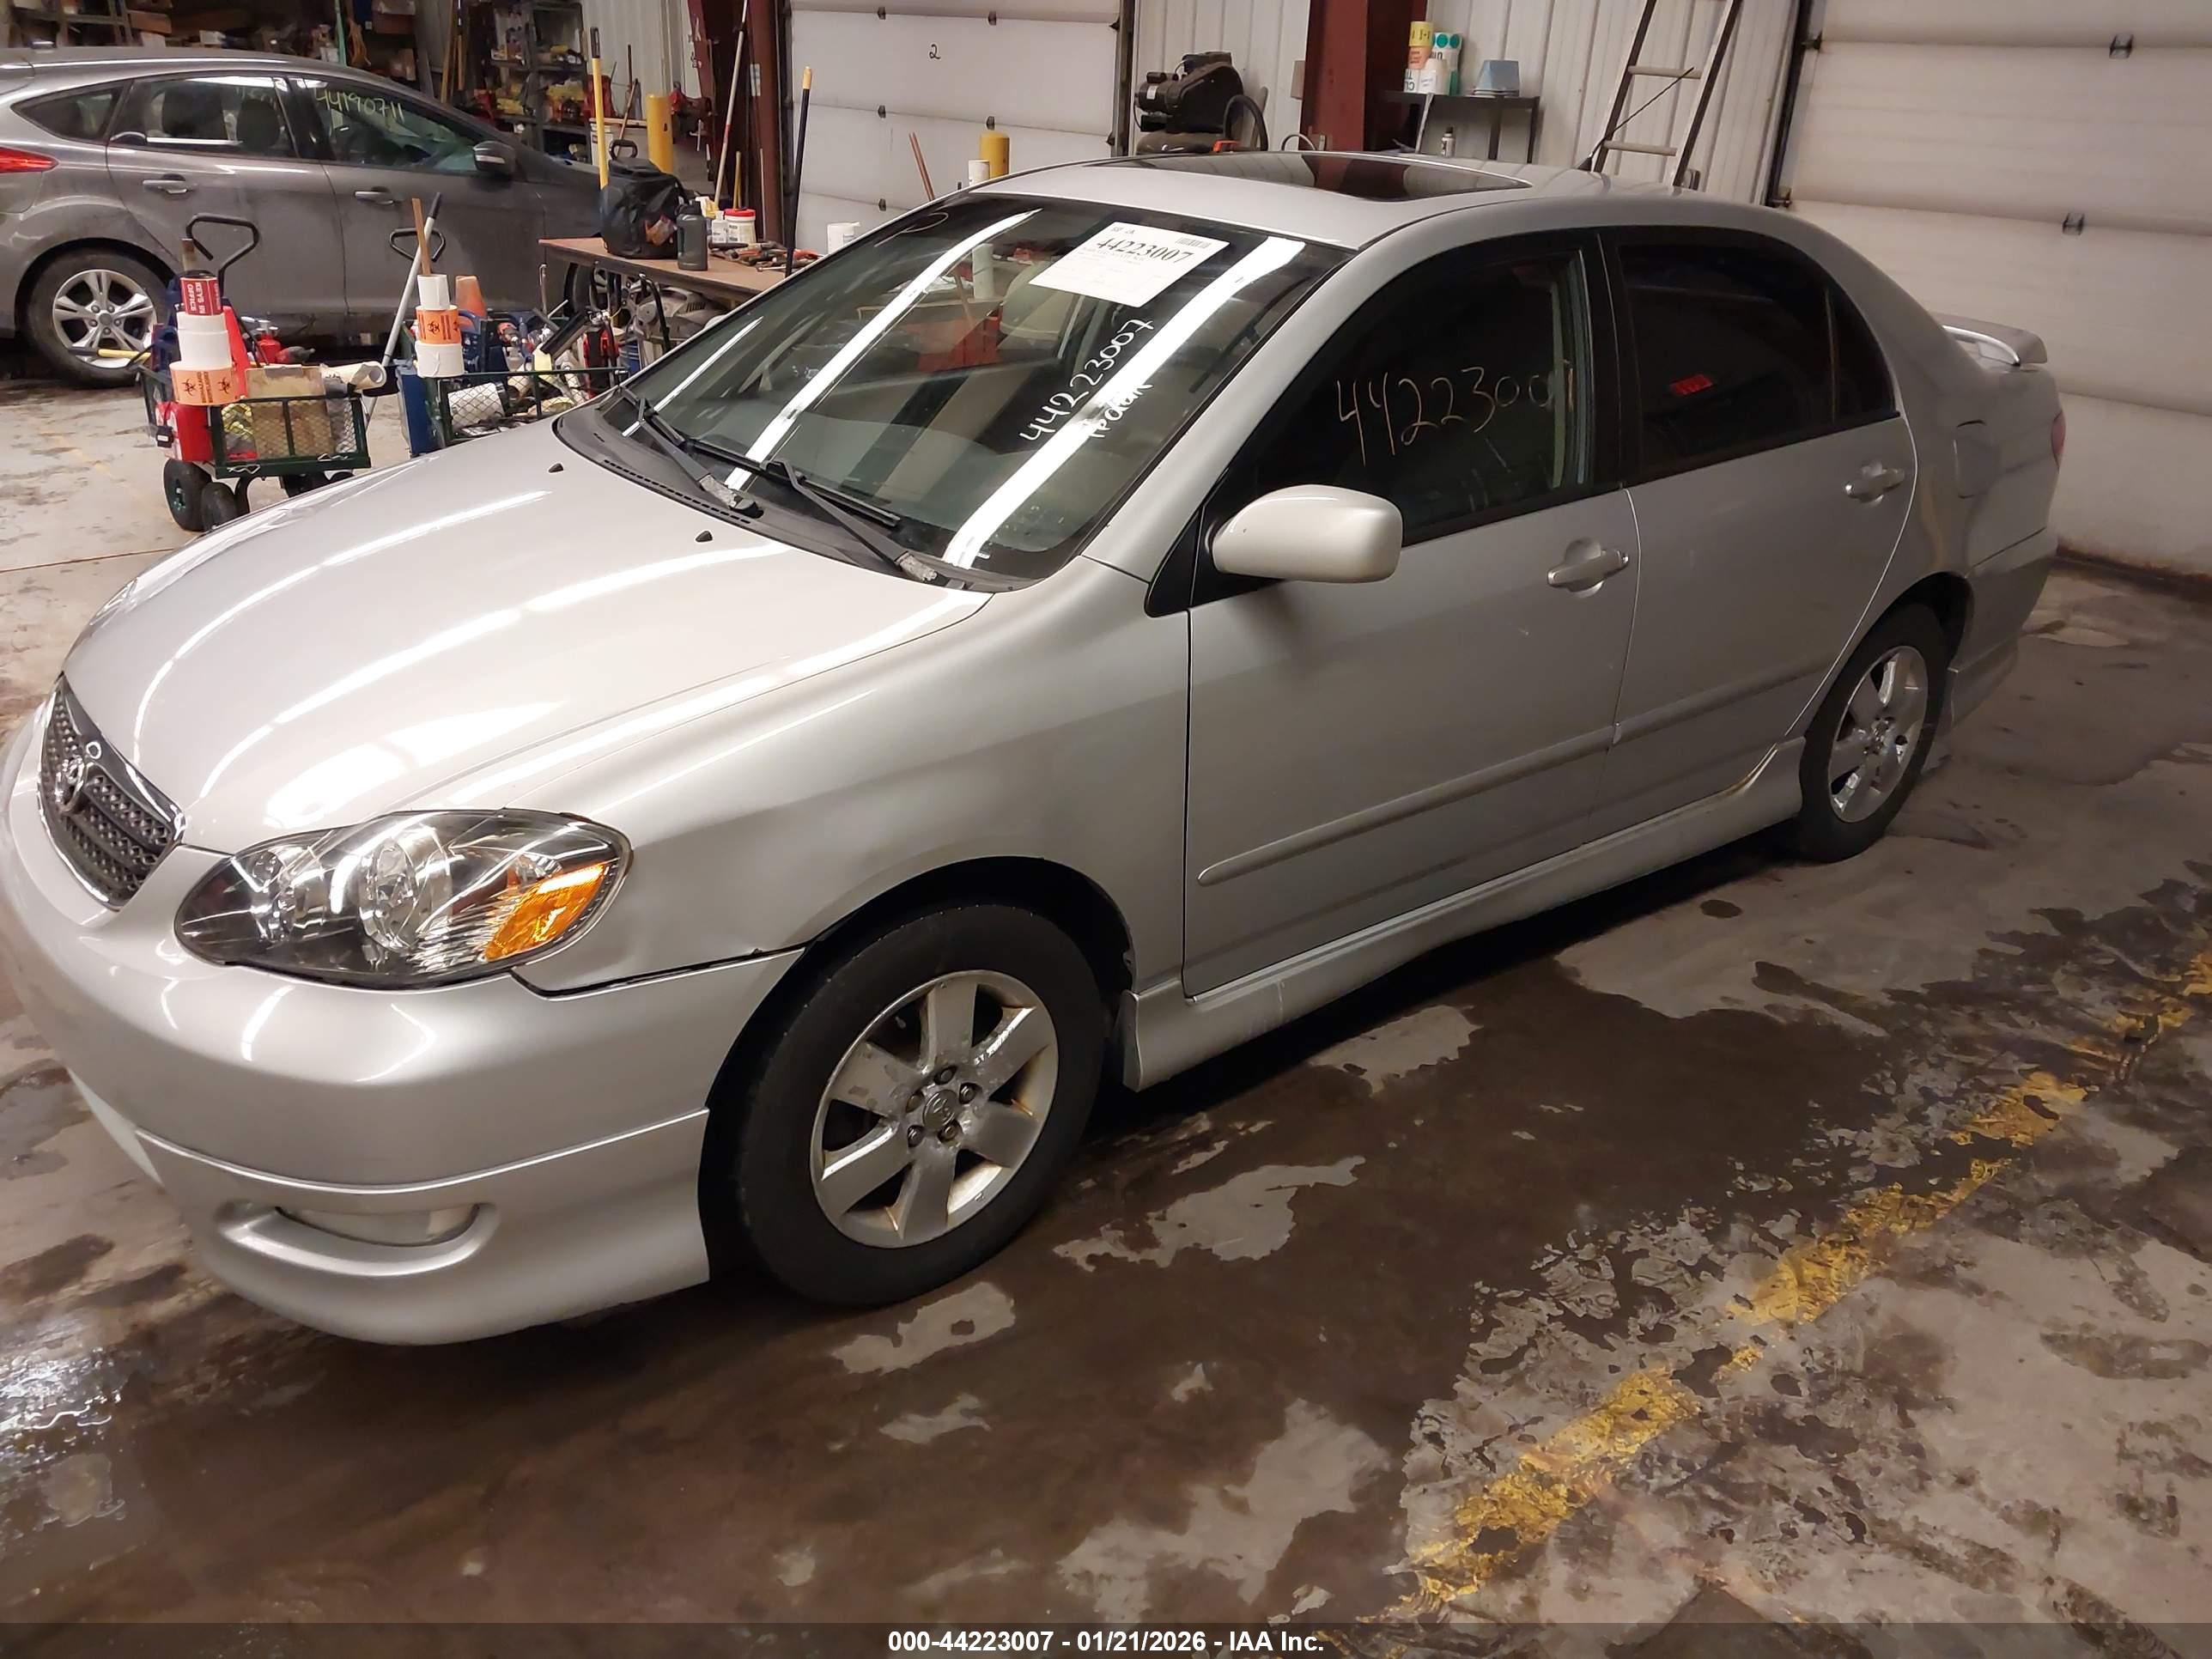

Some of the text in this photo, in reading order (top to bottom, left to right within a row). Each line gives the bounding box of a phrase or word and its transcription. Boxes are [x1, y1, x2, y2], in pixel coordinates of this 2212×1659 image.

[929, 44, 941, 59] 2
[313, 87, 404, 123] 44190711
[1097, 237, 1194, 263] 44223007
[187, 283, 197, 312] OFFICE
[195, 282, 204, 303] KEYS
[1019, 319, 1154, 441] 44223007
